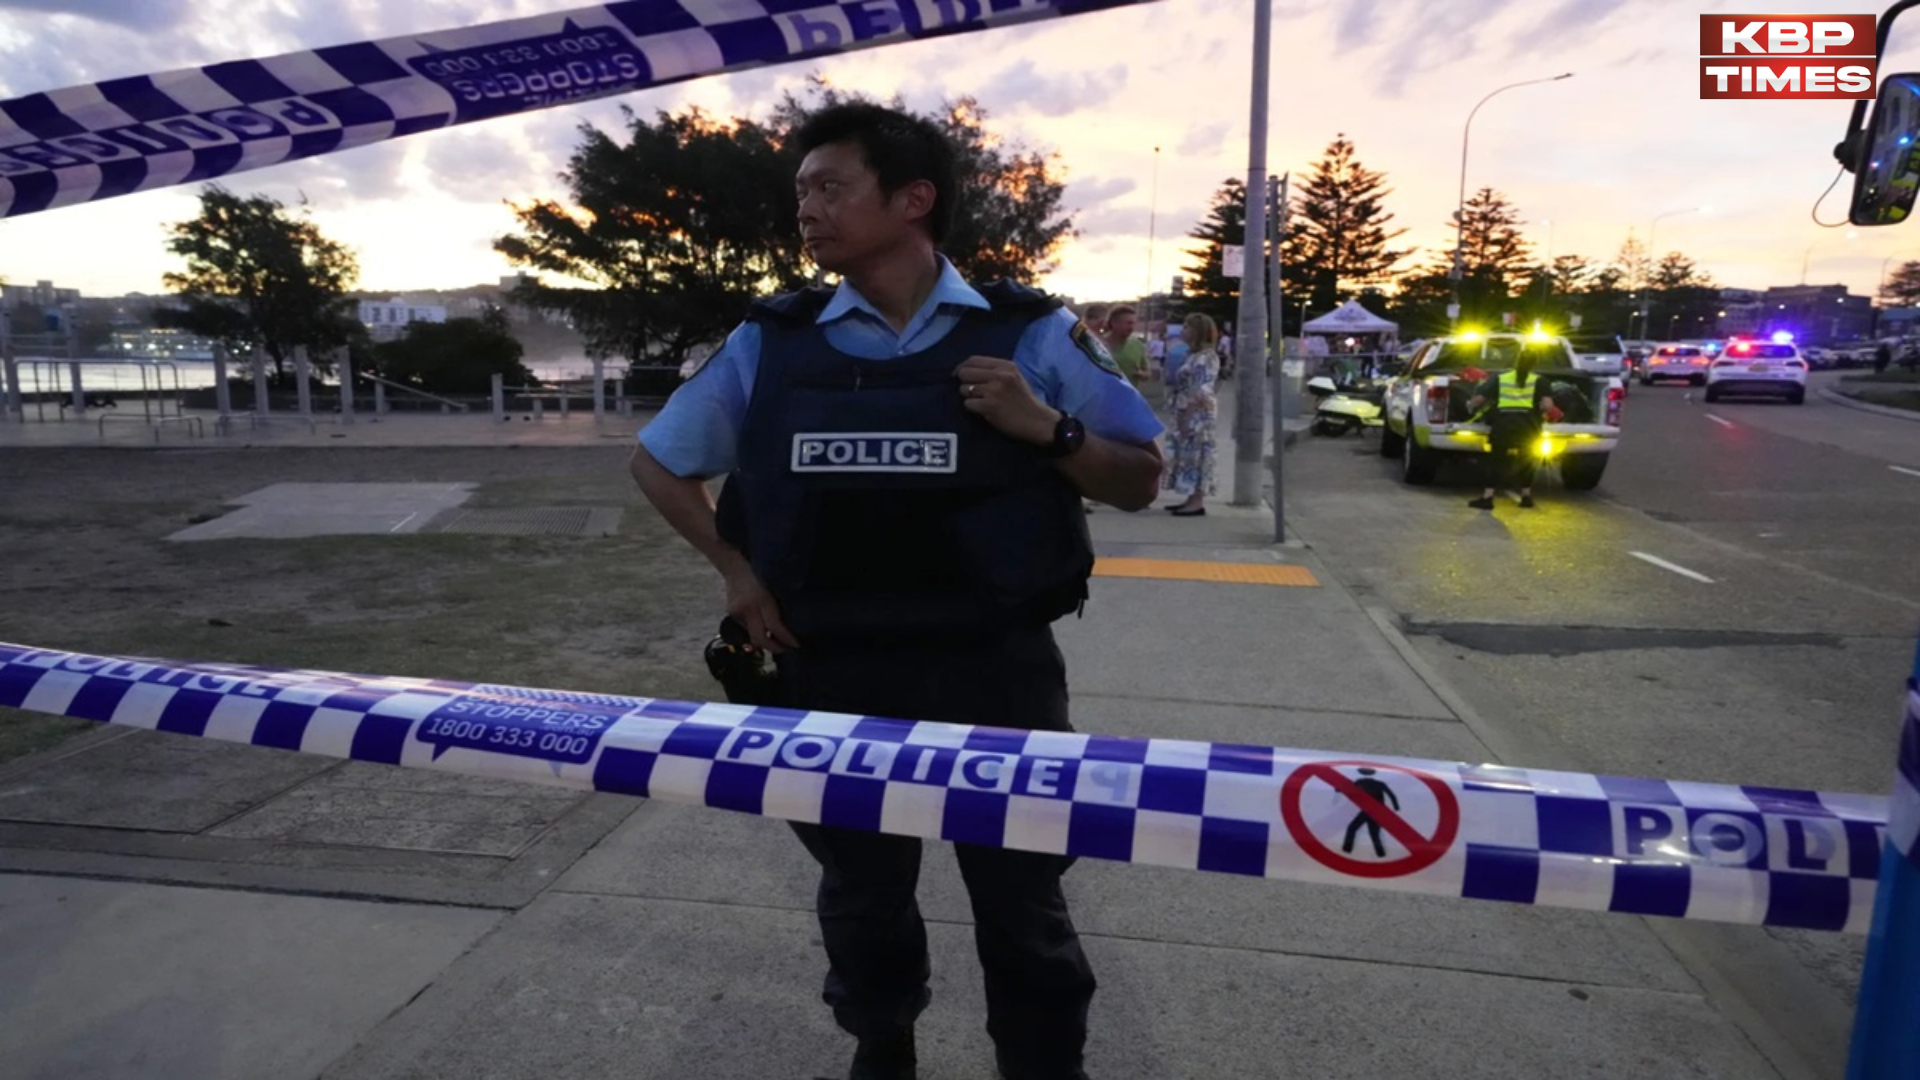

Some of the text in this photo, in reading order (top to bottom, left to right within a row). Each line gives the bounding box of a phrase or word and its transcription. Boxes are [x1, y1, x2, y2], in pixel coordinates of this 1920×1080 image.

[452, 53, 640, 101] STOPPERS
[801, 440, 947, 465] POLICE
[448, 701, 610, 730] STOPPERS
[426, 718, 589, 755] 1800 333 000
[727, 729, 1064, 796] POLICE
